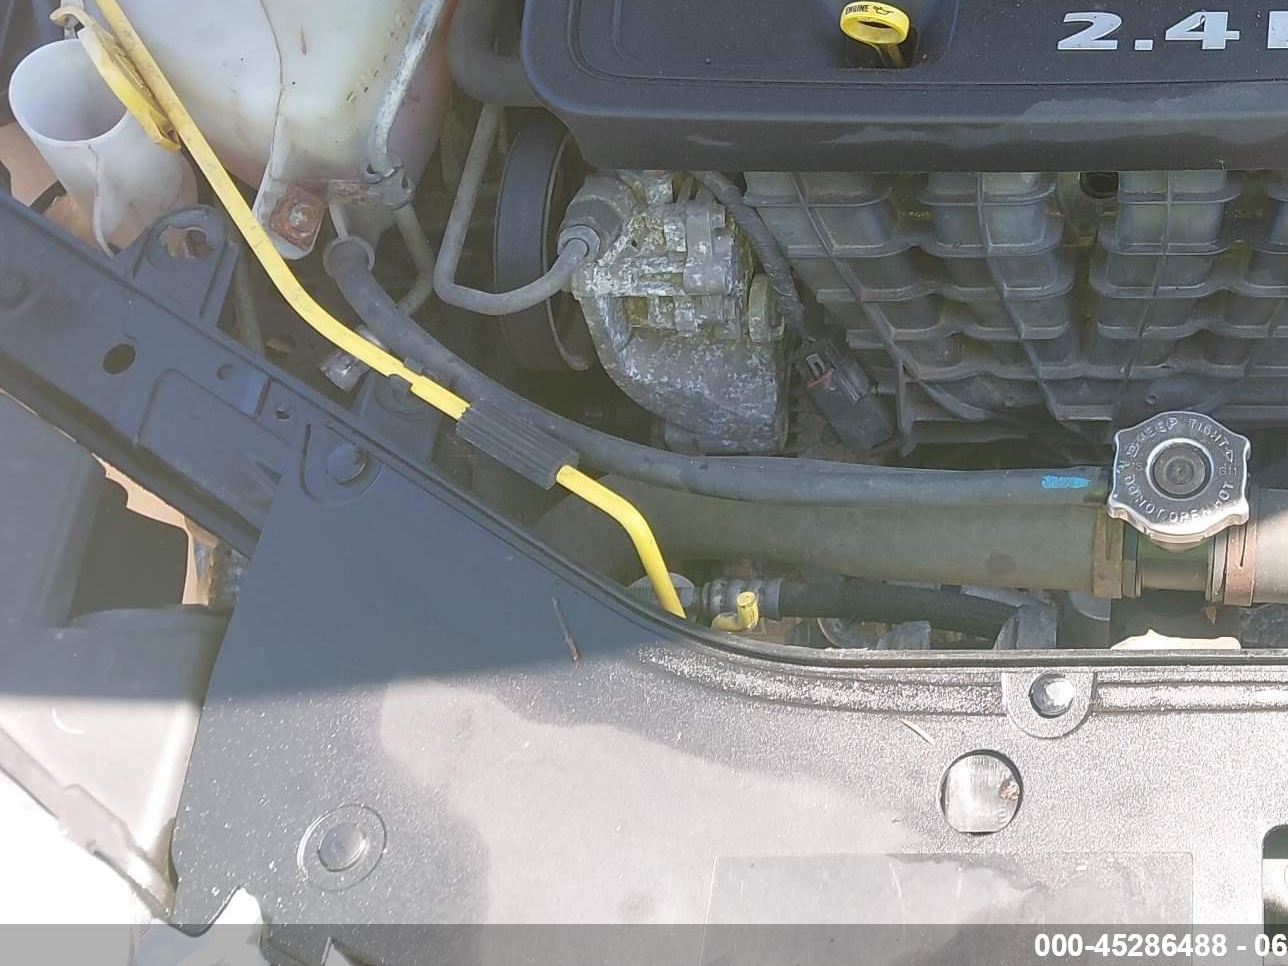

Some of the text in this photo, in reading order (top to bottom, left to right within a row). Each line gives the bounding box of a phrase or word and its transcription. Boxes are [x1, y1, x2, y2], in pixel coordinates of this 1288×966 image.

[845, 4, 870, 15] ENGINE
[1057, 10, 1240, 51] 2.4
[1137, 417, 1230, 448] KEEP TIGHT
